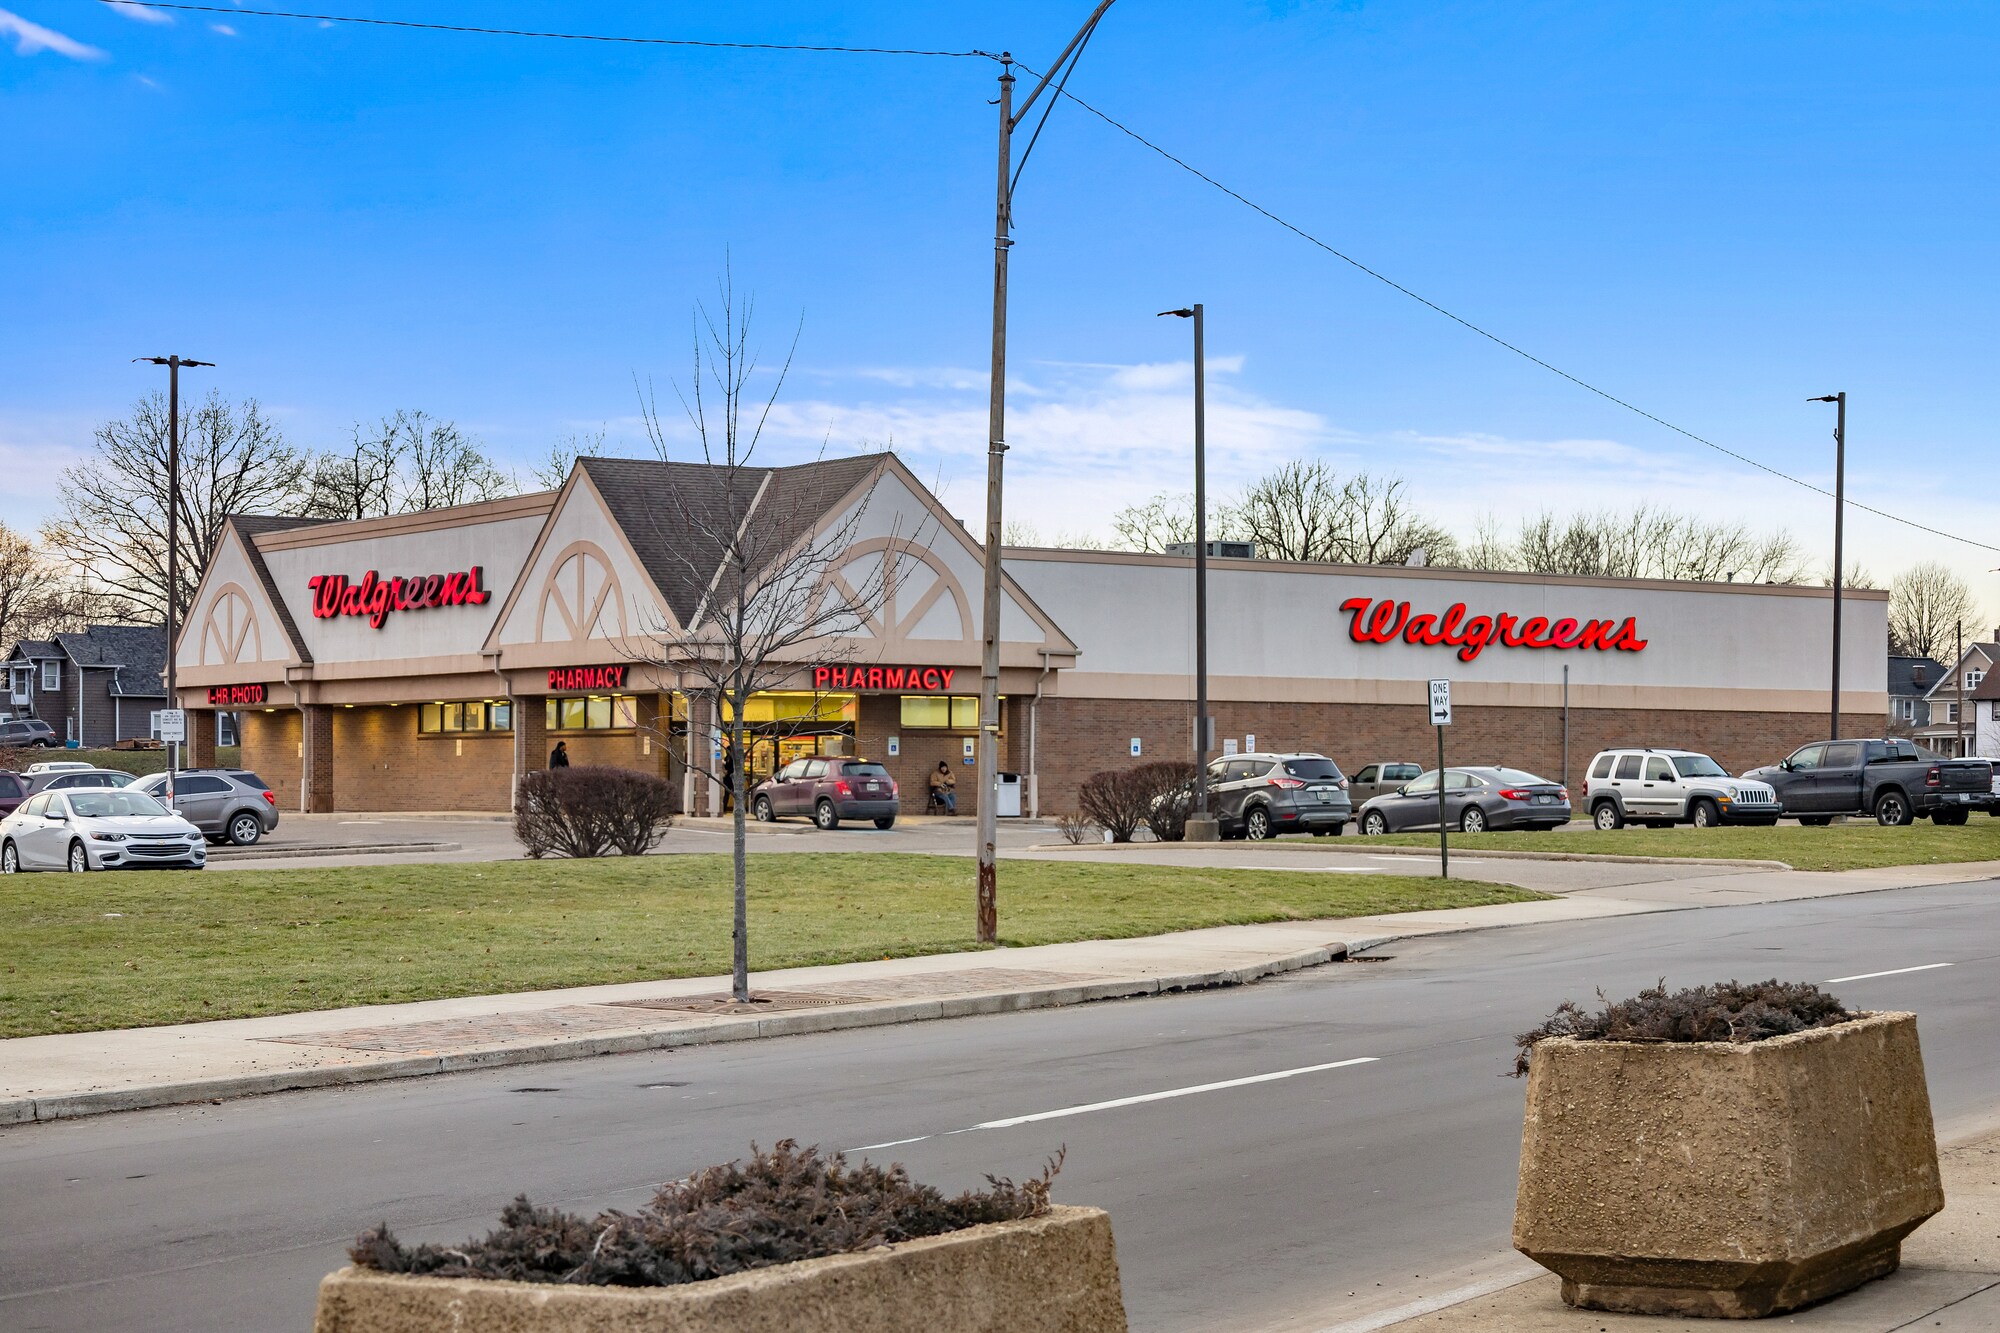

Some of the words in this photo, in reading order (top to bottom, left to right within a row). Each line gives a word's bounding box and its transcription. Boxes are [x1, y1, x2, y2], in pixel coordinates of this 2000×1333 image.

[308, 566, 491, 629] Walgreens
[1339, 597, 1648, 662] Walgreens
[548, 666, 624, 690] PHARMACY
[814, 667, 955, 691] PHARMACY
[1433, 683, 1447, 694] ONE
[207, 687, 229, 705] 1-HR
[231, 685, 263, 703] PHOTO
[1433, 695, 1448, 706] WAY
